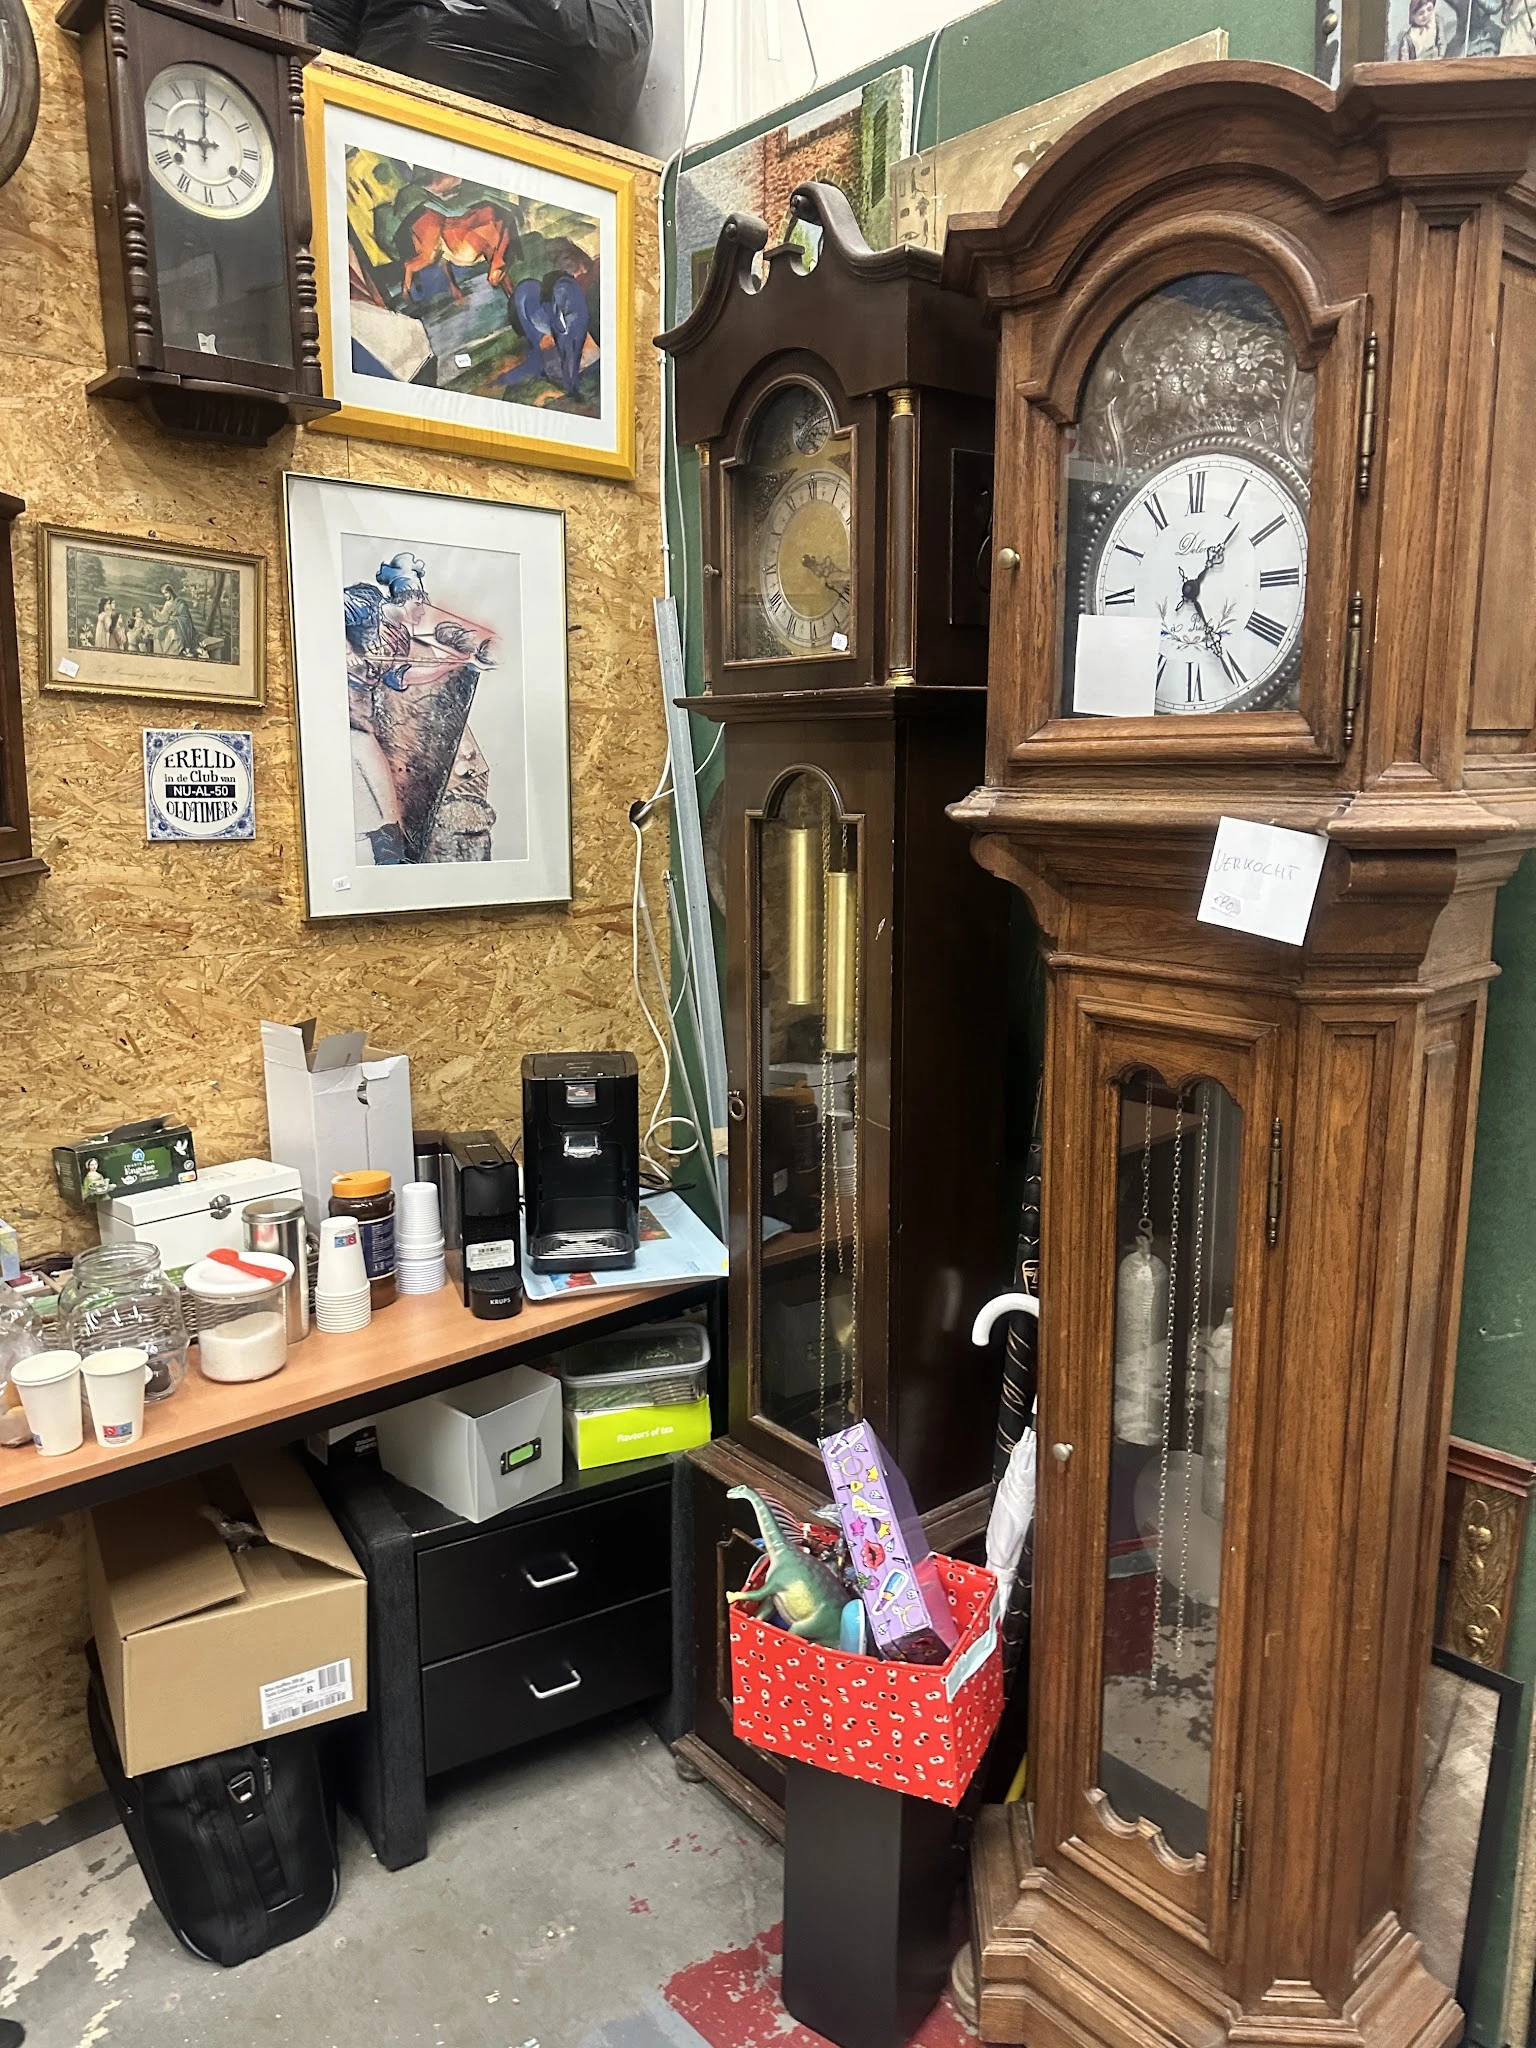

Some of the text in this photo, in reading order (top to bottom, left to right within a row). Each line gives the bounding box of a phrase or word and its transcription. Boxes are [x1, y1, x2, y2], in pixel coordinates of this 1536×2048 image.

[1185, 471, 1209, 517] XII
[1143, 491, 1170, 536] XI
[1249, 512, 1289, 548] II
[1115, 538, 1145, 566] X
[1259, 565, 1299, 591] III
[1104, 585, 1136, 606] IX
[1244, 608, 1289, 650] IIII
[1185, 662, 1205, 702] VI
[164, 748, 236, 768] ERELID
[164, 774, 174, 782] in
[177, 774, 188, 782] de
[190, 770, 218, 783] Club
[173, 785, 228, 796] NU-AL-50
[166, 800, 238, 823] OLDTIMERS
[1213, 848, 1301, 880] VERKOCHT
[490, 1297, 511, 1305] KRUPS
[617, 1429, 650, 1442] Flavours
[650, 1428, 660, 1436] of
